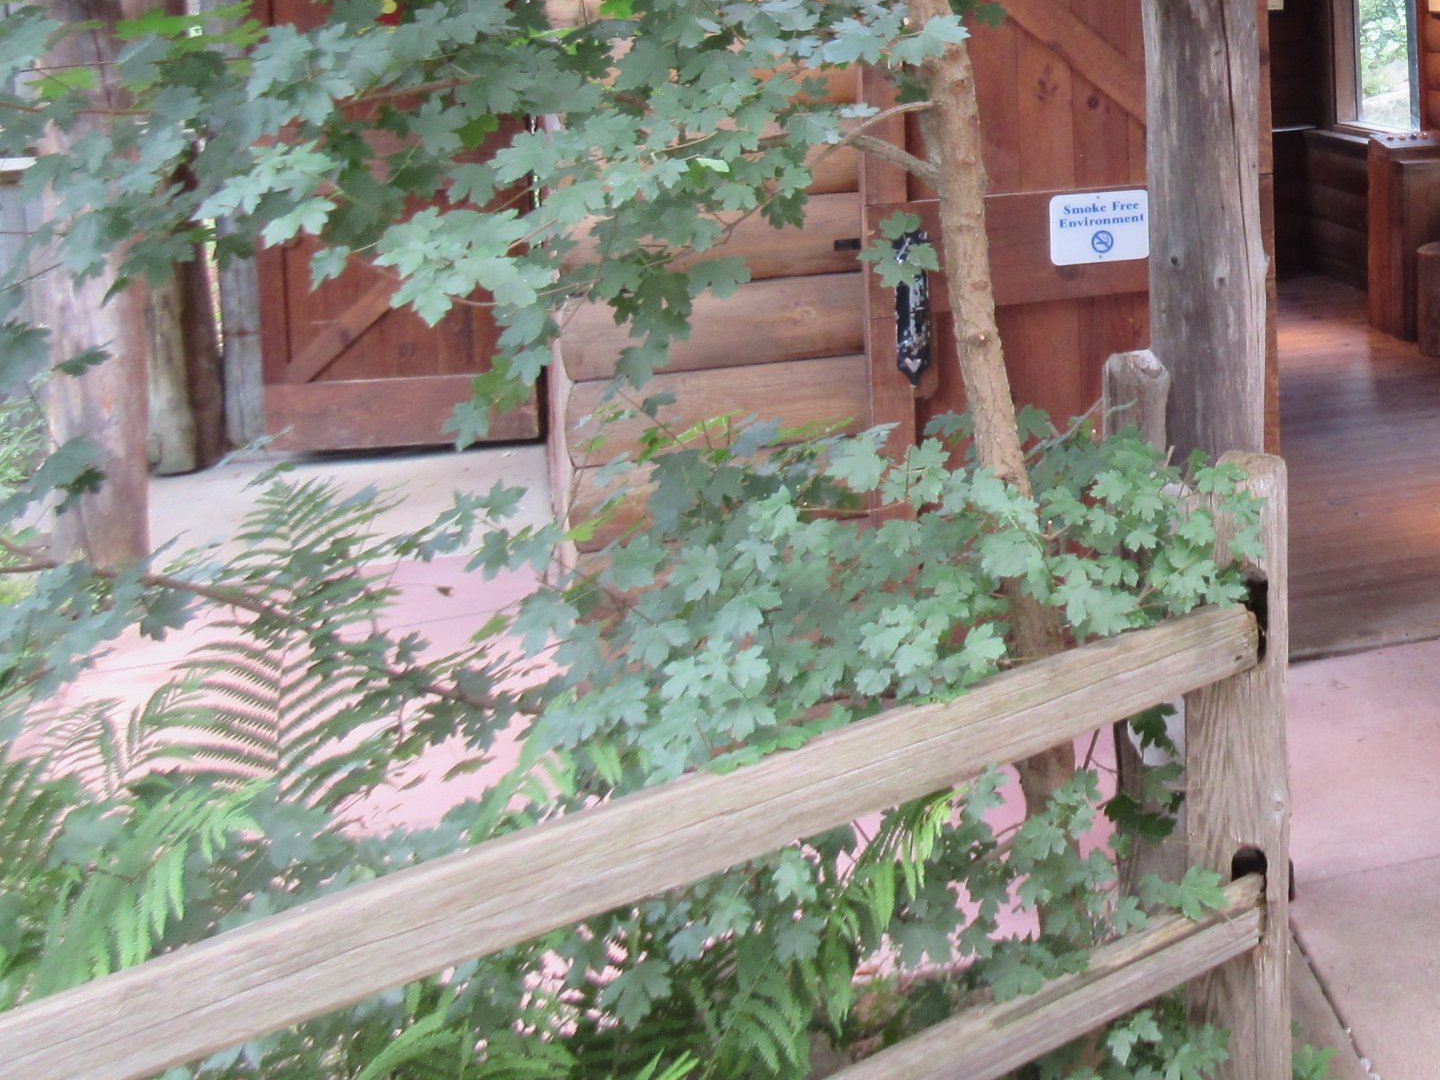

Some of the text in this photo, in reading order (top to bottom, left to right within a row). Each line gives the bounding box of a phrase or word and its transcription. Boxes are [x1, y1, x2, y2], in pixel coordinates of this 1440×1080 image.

[1063, 201, 1139, 214] Smoke Free
[1059, 213, 1145, 229] Environment
